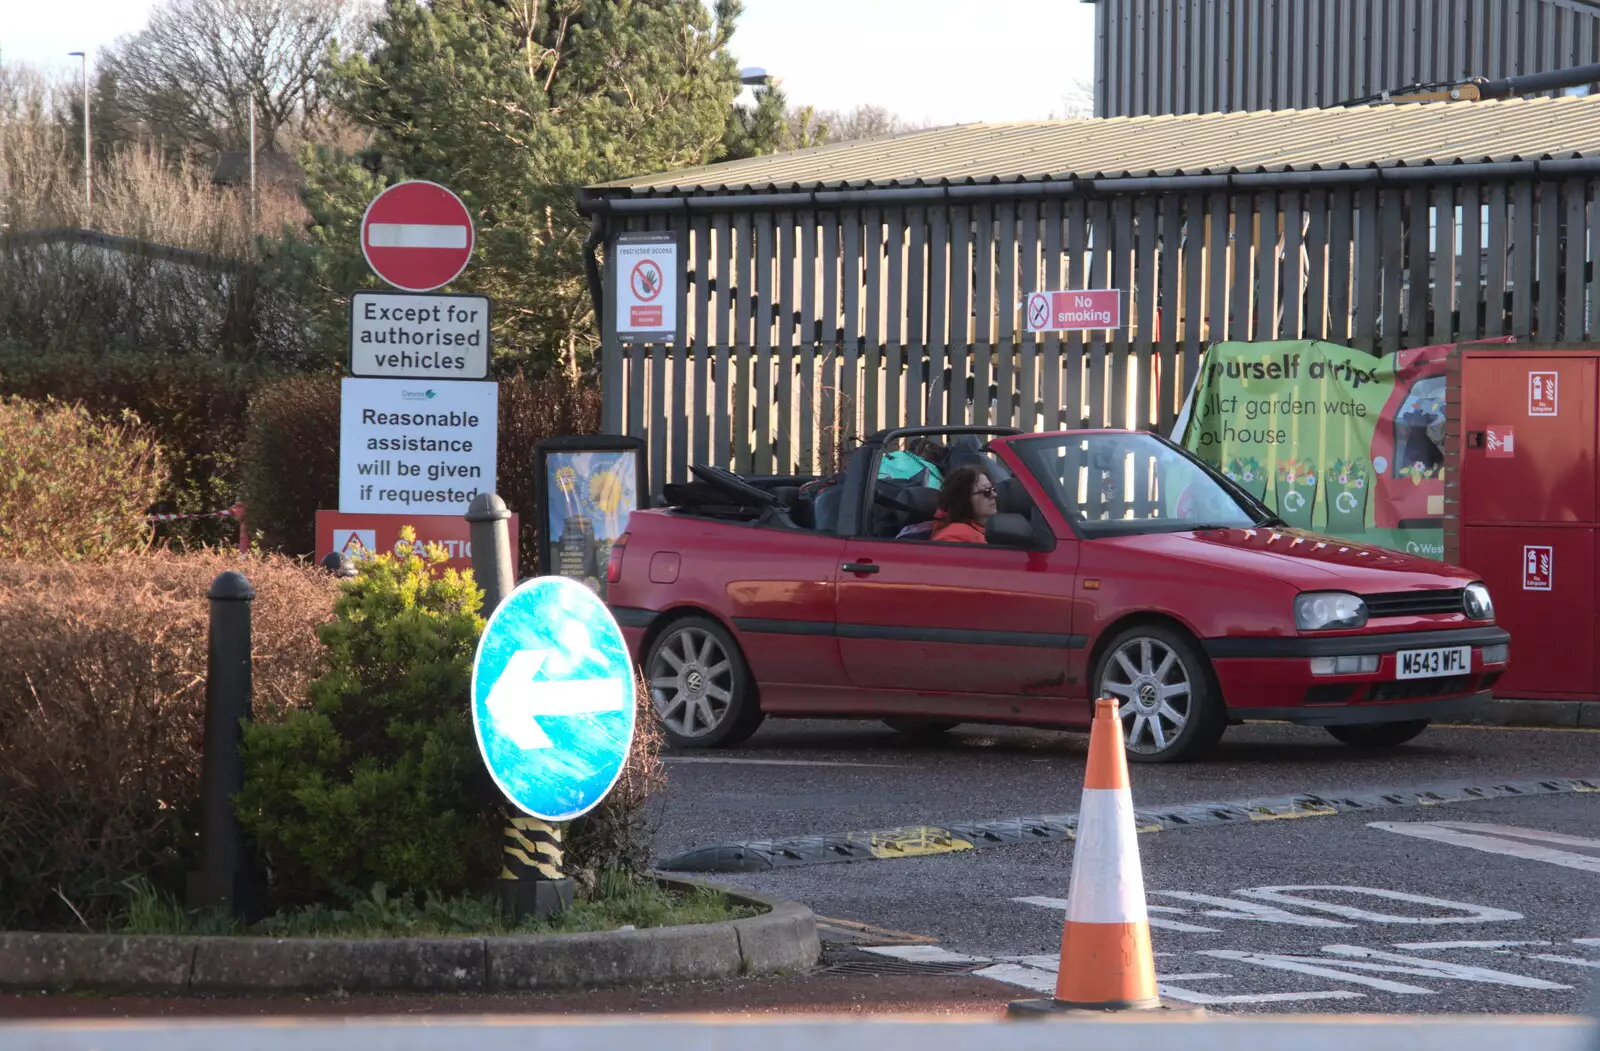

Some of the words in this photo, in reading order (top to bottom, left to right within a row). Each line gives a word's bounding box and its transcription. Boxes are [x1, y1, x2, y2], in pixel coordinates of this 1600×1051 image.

[620, 247, 650, 255] restricted
[651, 247, 673, 255] access
[1074, 295, 1093, 308] No
[364, 303, 441, 324] Except
[447, 305, 478, 323] for
[1058, 309, 1111, 324] smoking
[360, 327, 480, 346] authorised
[375, 350, 466, 369] vehicles
[1246, 392, 1316, 420] garden
[362, 408, 479, 427] Reasonable
[1223, 420, 1286, 444] house
[367, 435, 473, 452] assistance
[357, 460, 391, 475] will
[397, 460, 420, 476] be
[427, 461, 481, 481] given
[360, 485, 373, 500] if
[379, 487, 478, 506] requested
[1402, 651, 1439, 675] M543
[1442, 649, 1466, 672] WFL
